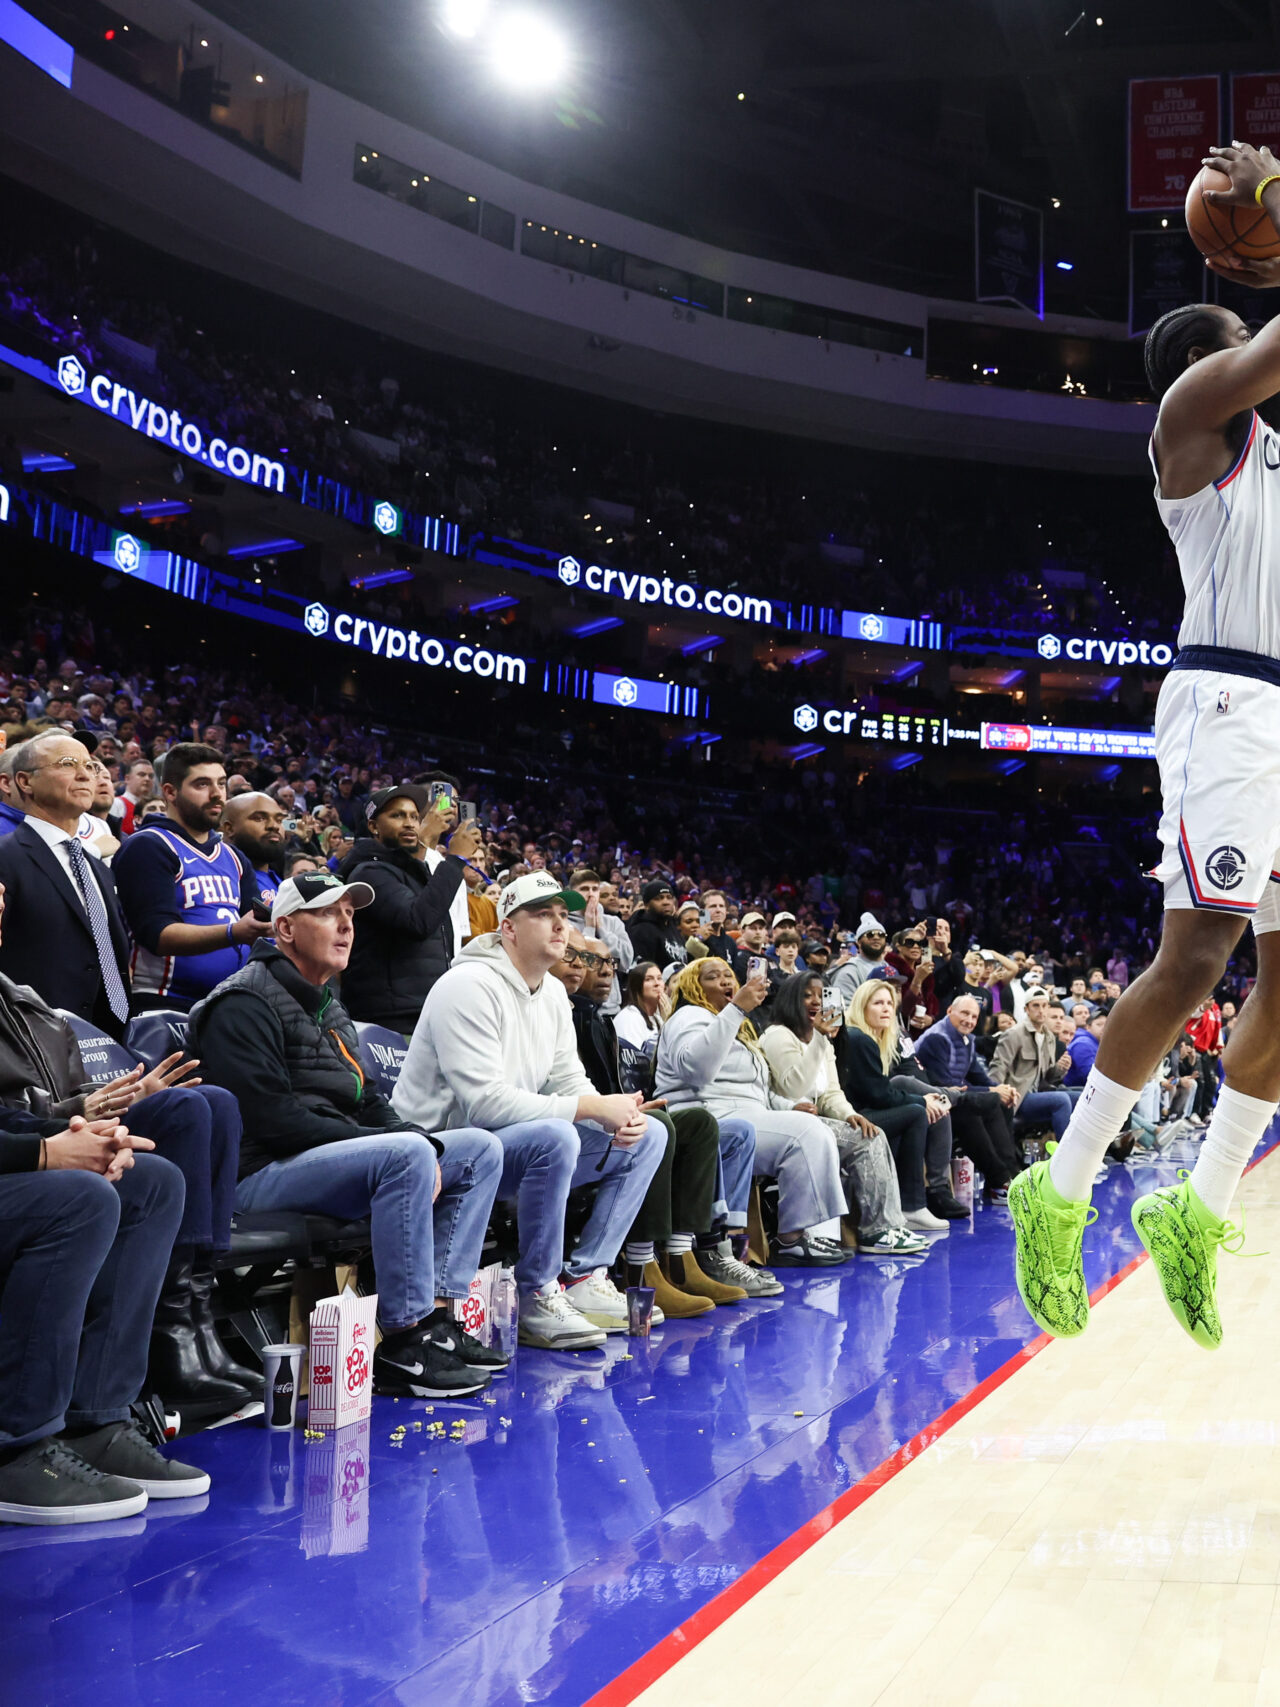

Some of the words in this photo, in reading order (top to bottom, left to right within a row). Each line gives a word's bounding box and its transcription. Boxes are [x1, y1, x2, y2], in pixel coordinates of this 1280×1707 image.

[90, 374, 285, 493] crypto.com
[585, 565, 773, 624] crypto.com
[334, 613, 526, 685] crypto.com
[861, 728, 878, 738] LAC
[916, 725, 924, 734] 4
[932, 726, 939, 735] 7
[462, 1297, 480, 1317] POP
[352, 1323, 367, 1343] fresh
[313, 1365, 331, 1376] POP
[346, 1348, 365, 1373] POP
[313, 1376, 333, 1385] CORN
[348, 1360, 369, 1391] CORN
